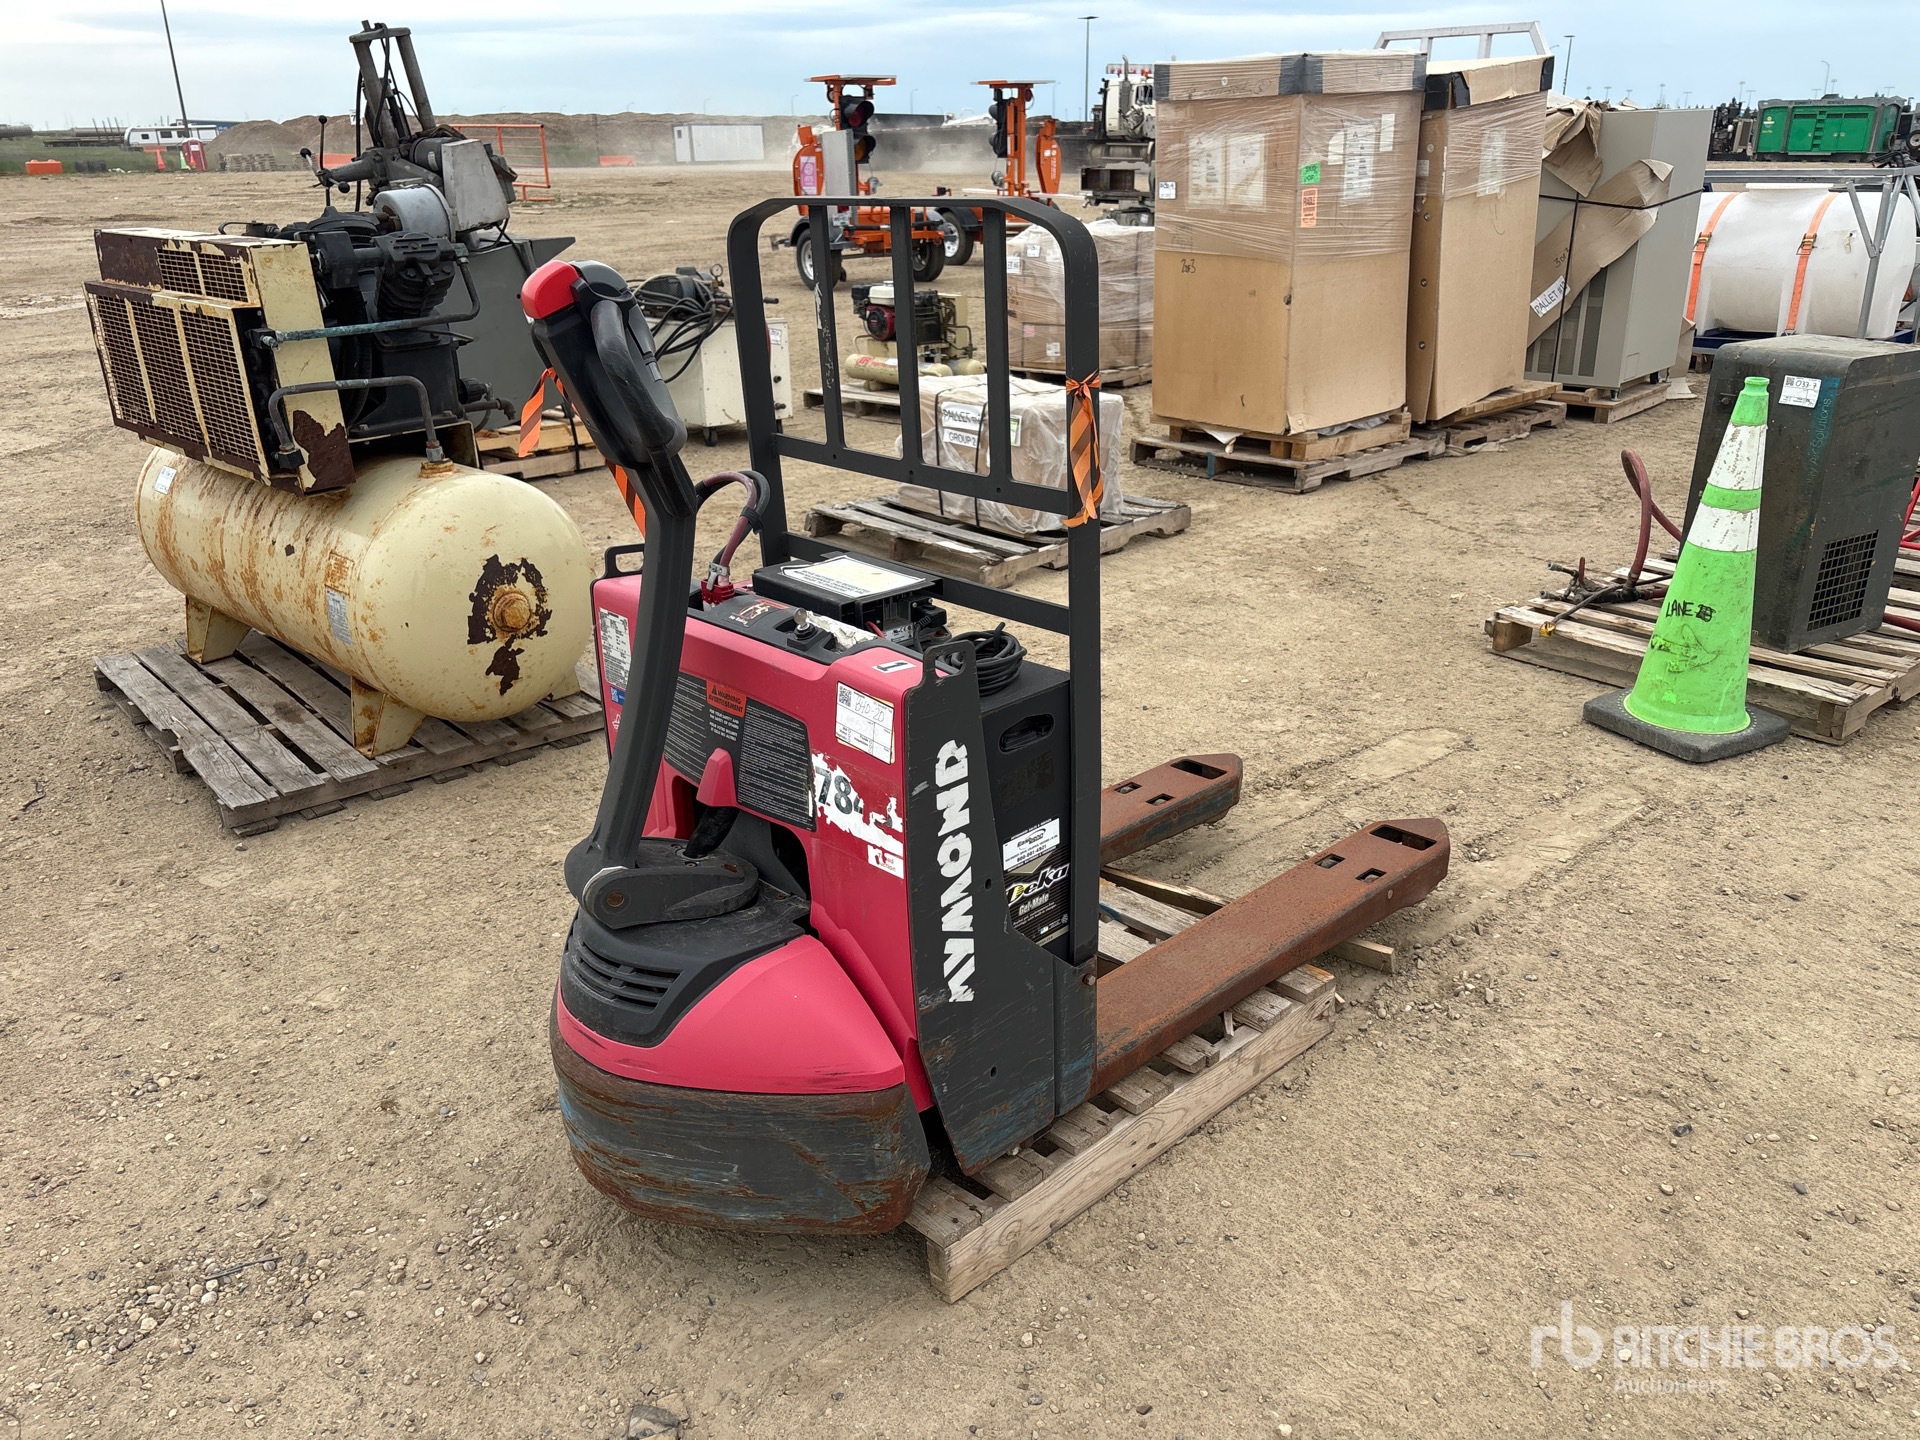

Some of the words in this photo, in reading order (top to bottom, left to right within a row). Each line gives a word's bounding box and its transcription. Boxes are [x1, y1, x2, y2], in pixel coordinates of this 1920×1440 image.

[1534, 290, 1559, 313] PALLET
[1813, 398, 1832, 448] Solutions
[949, 432, 971, 445] GROUP
[972, 437, 977, 447] 2
[1665, 599, 1694, 618] LANE
[708, 694, 744, 713] AVERTISSEMENT
[717, 690, 742, 704] WARNING
[1005, 863, 1070, 907] Deka
[1018, 892, 1050, 916] Gel-Mate
